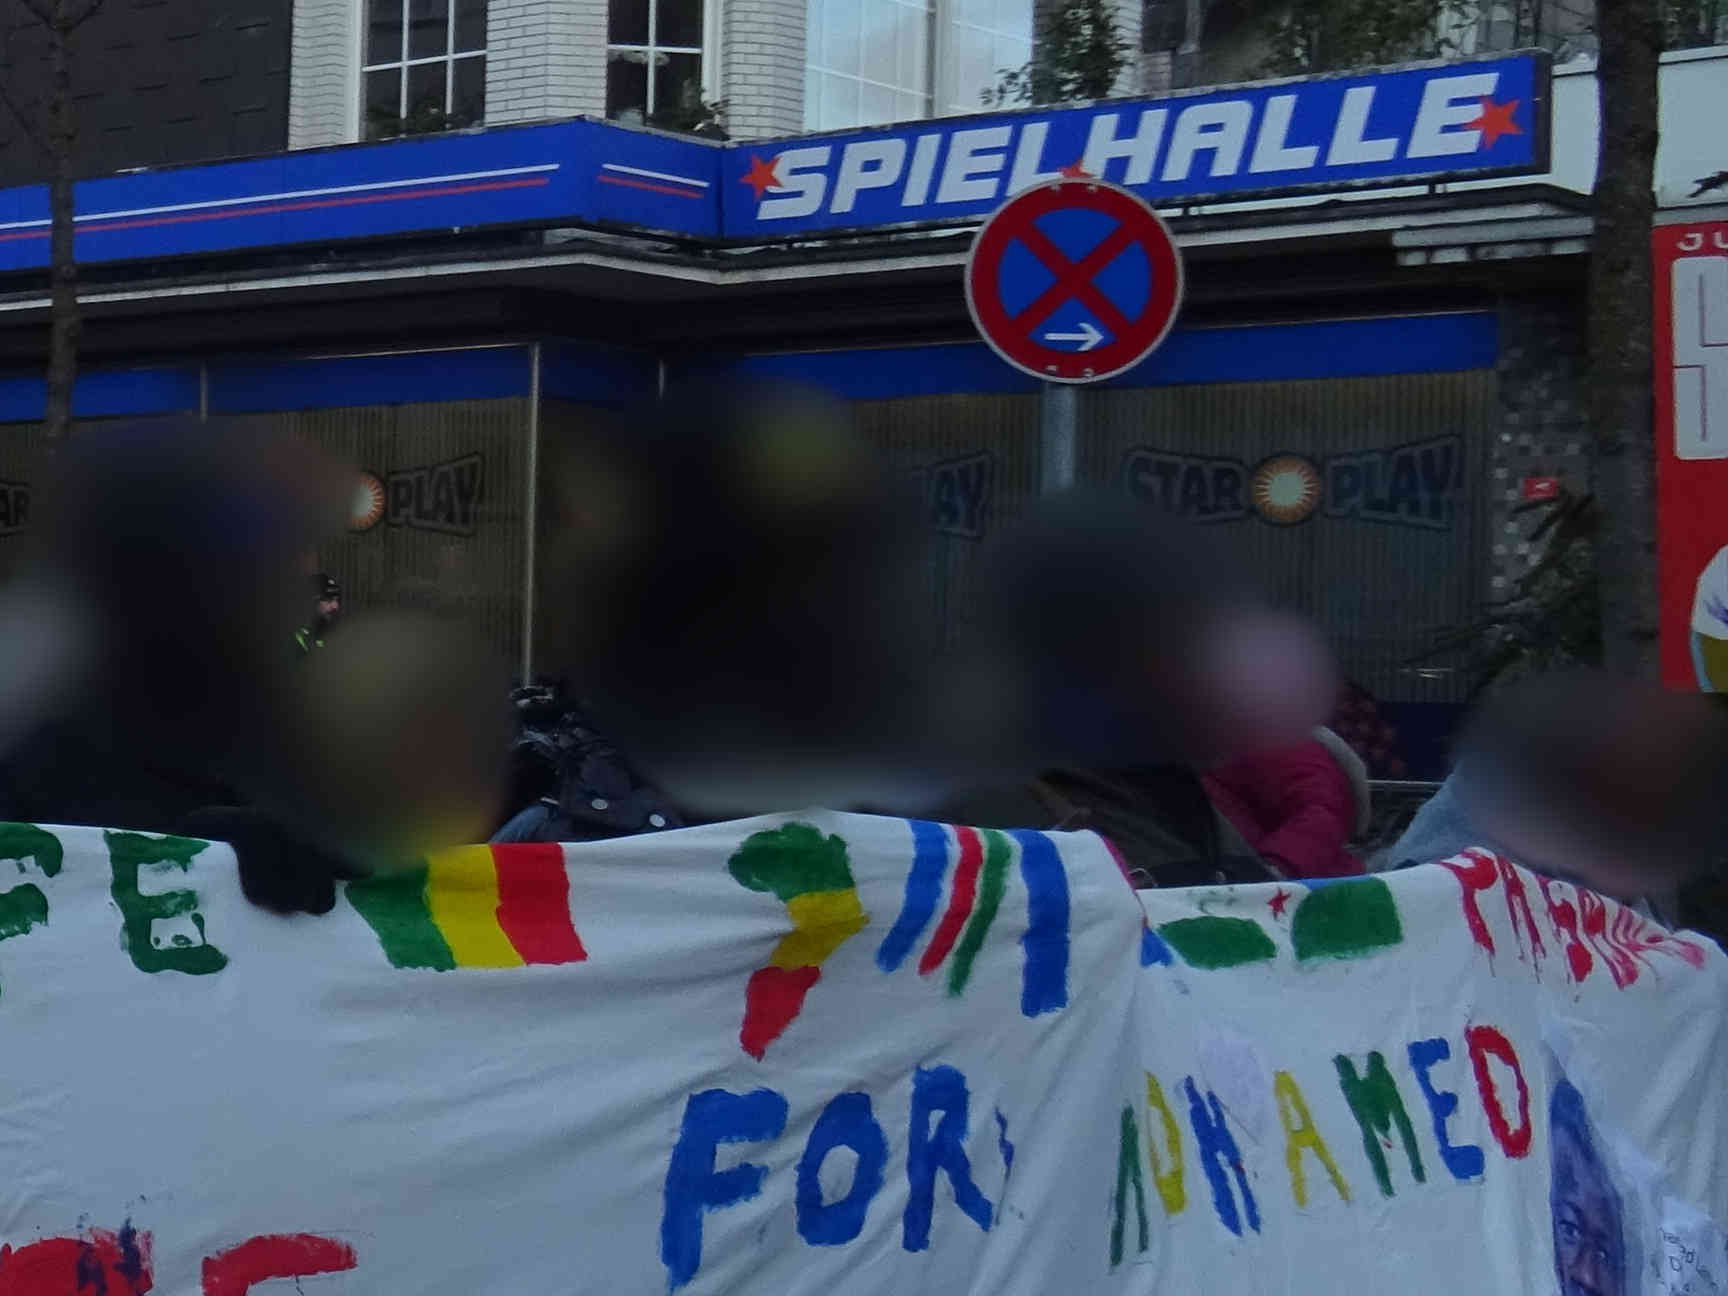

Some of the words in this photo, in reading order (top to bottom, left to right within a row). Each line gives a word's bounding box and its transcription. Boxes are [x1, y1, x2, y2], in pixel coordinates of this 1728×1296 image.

[756, 72, 1500, 221] SPIELHALLE
[1330, 439, 1456, 521] PLAY
[660, 1064, 994, 1296] FOR
